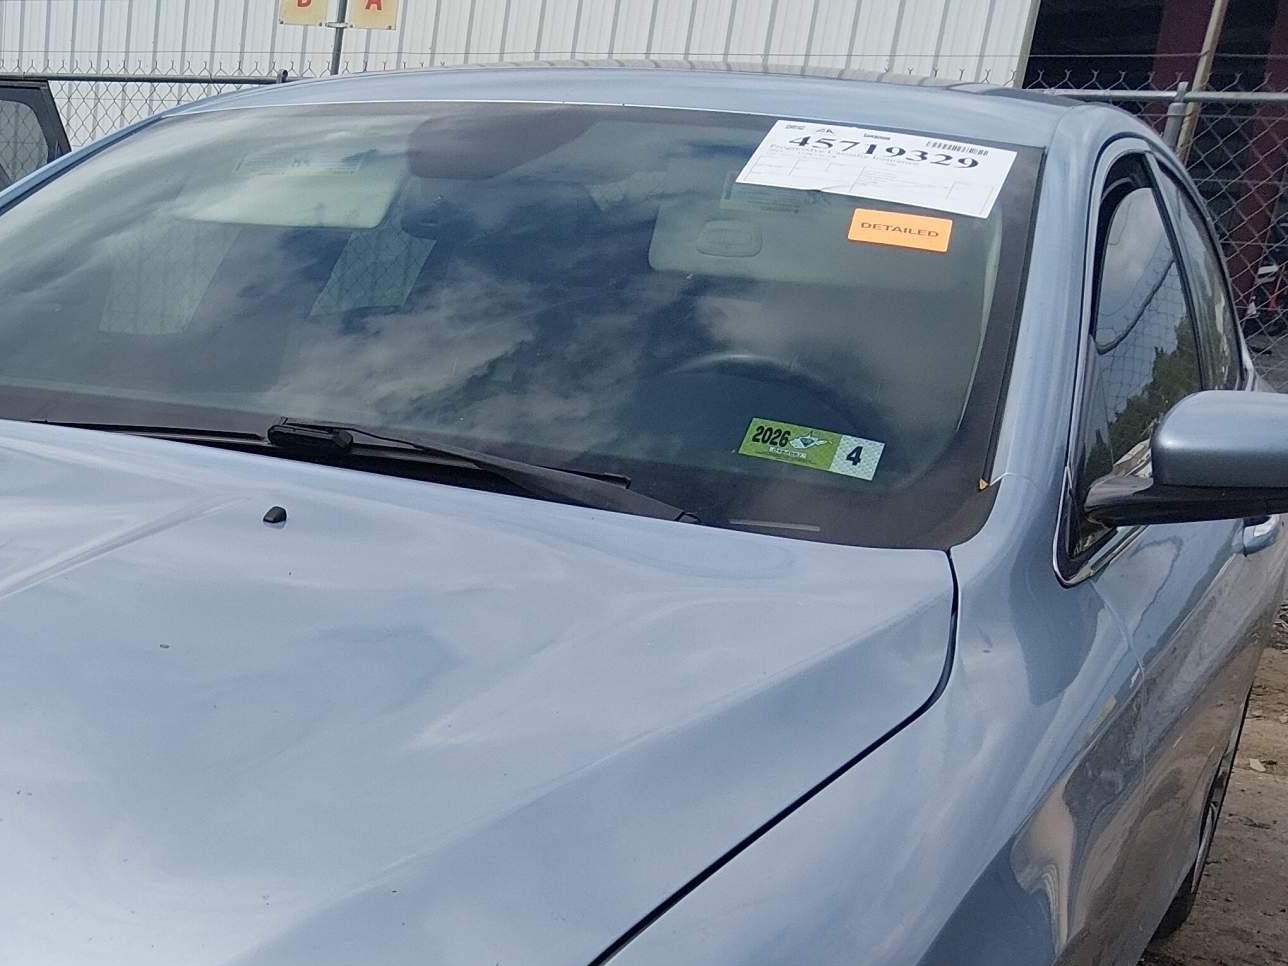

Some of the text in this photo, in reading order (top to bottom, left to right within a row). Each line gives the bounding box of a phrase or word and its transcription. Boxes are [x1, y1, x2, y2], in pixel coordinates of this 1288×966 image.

[788, 135, 979, 168] 45719329
[860, 222, 940, 238] DETAILED
[751, 425, 864, 466] 2026 4
